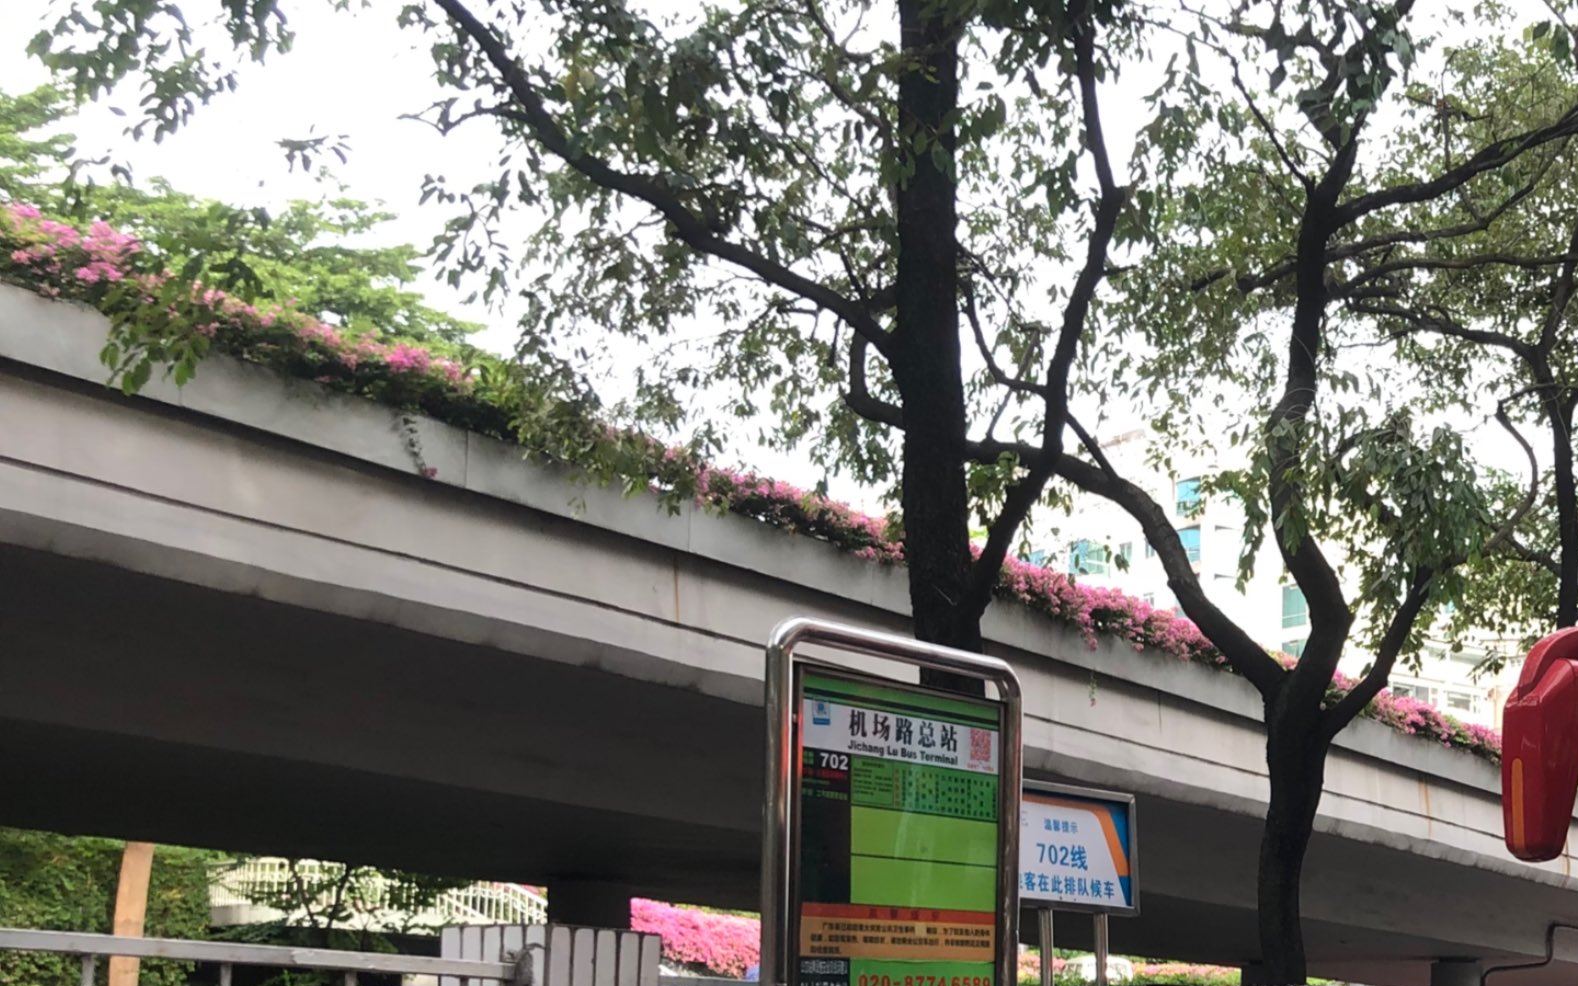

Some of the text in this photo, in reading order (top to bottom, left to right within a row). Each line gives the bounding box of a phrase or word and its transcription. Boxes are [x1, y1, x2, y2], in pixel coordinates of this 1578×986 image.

[849, 709, 958, 752] 机场路总站
[820, 752, 848, 771] 702
[848, 739, 958, 766] Jichang Lu Bus Terminal
[1036, 842, 1088, 871] 702线
